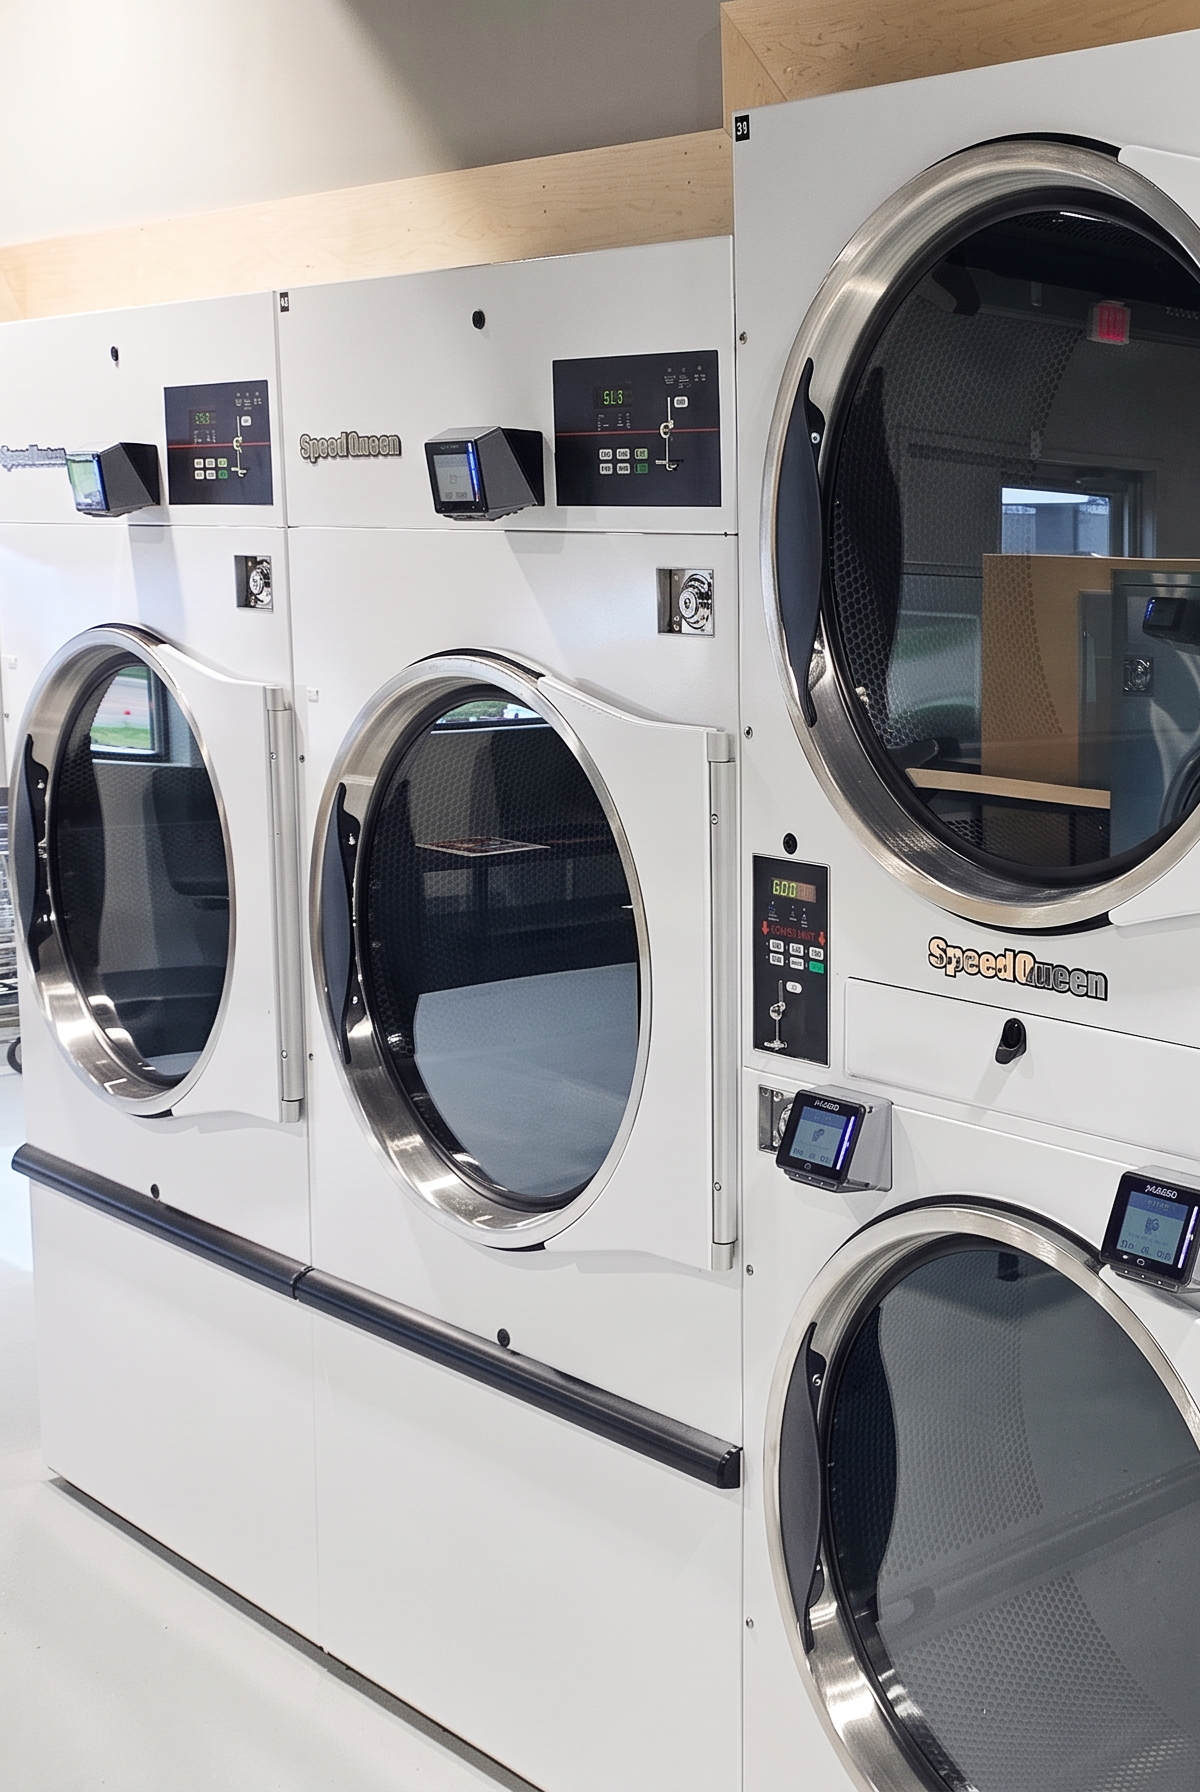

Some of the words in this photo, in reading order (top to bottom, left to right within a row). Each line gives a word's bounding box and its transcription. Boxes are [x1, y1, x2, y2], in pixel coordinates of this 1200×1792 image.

[736, 121, 748, 136] 39
[300, 431, 348, 463] Speed
[348, 431, 402, 457] Queen
[928, 936, 1016, 983] Speed
[1015, 950, 1108, 1001] Queen
